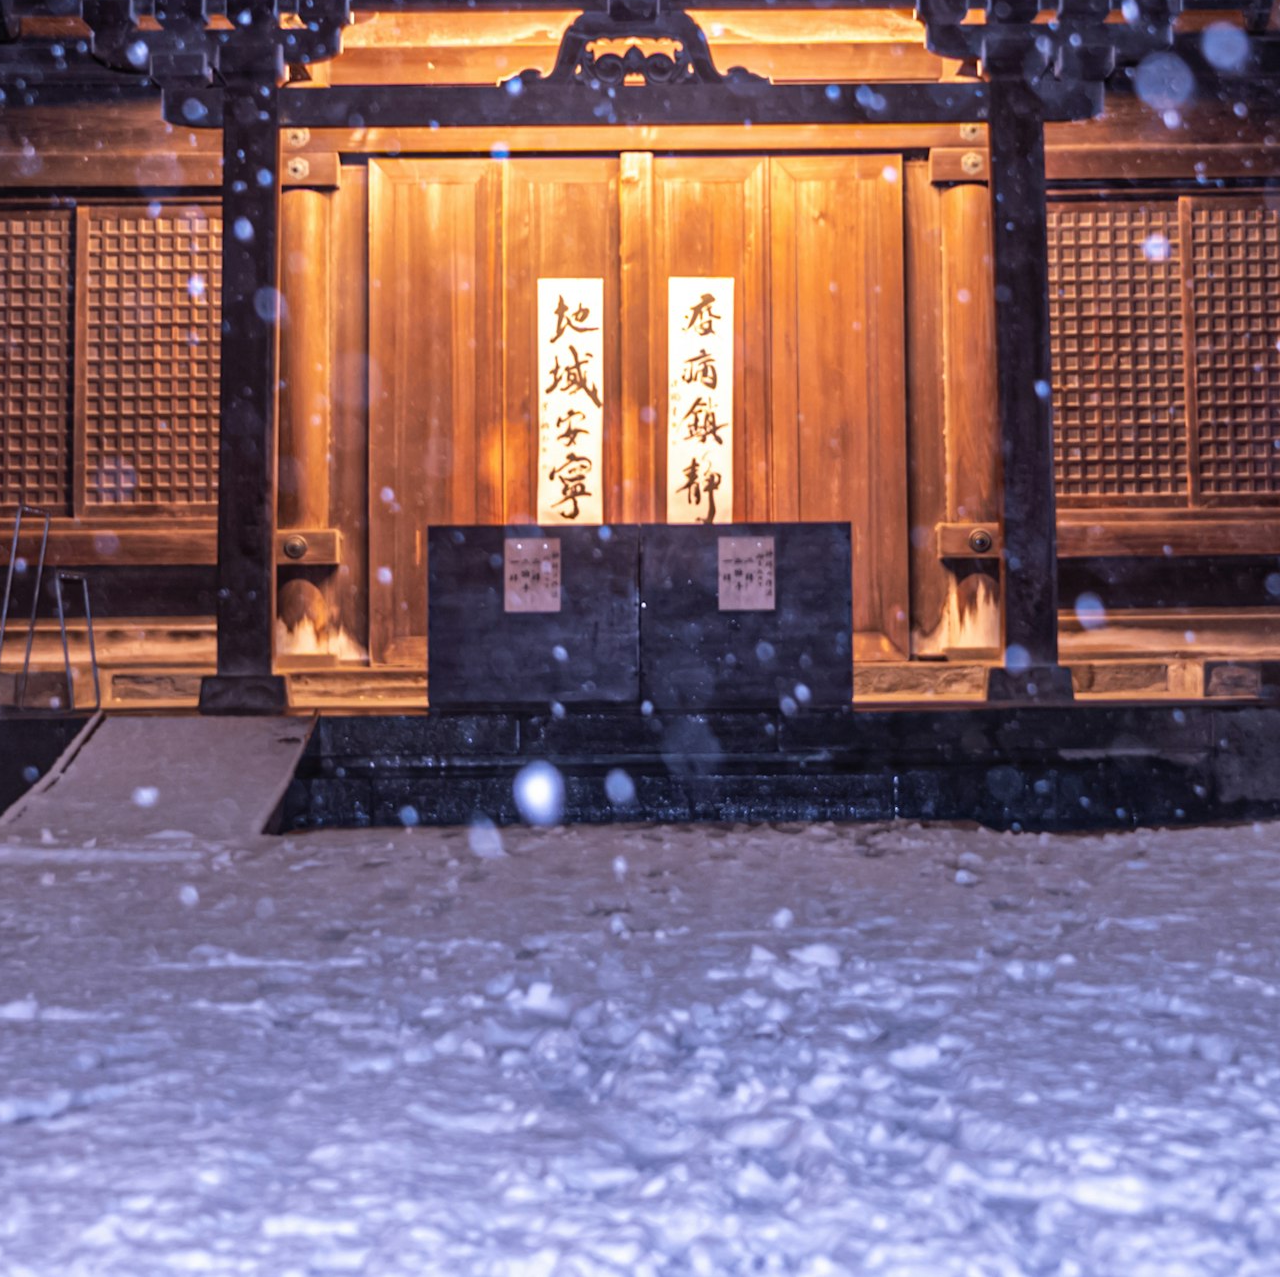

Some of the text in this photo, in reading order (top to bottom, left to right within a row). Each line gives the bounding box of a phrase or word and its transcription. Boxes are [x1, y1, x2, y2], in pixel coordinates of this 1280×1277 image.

[545, 294, 602, 520] 地域安寧
[676, 293, 729, 525] 疫病鎮静
